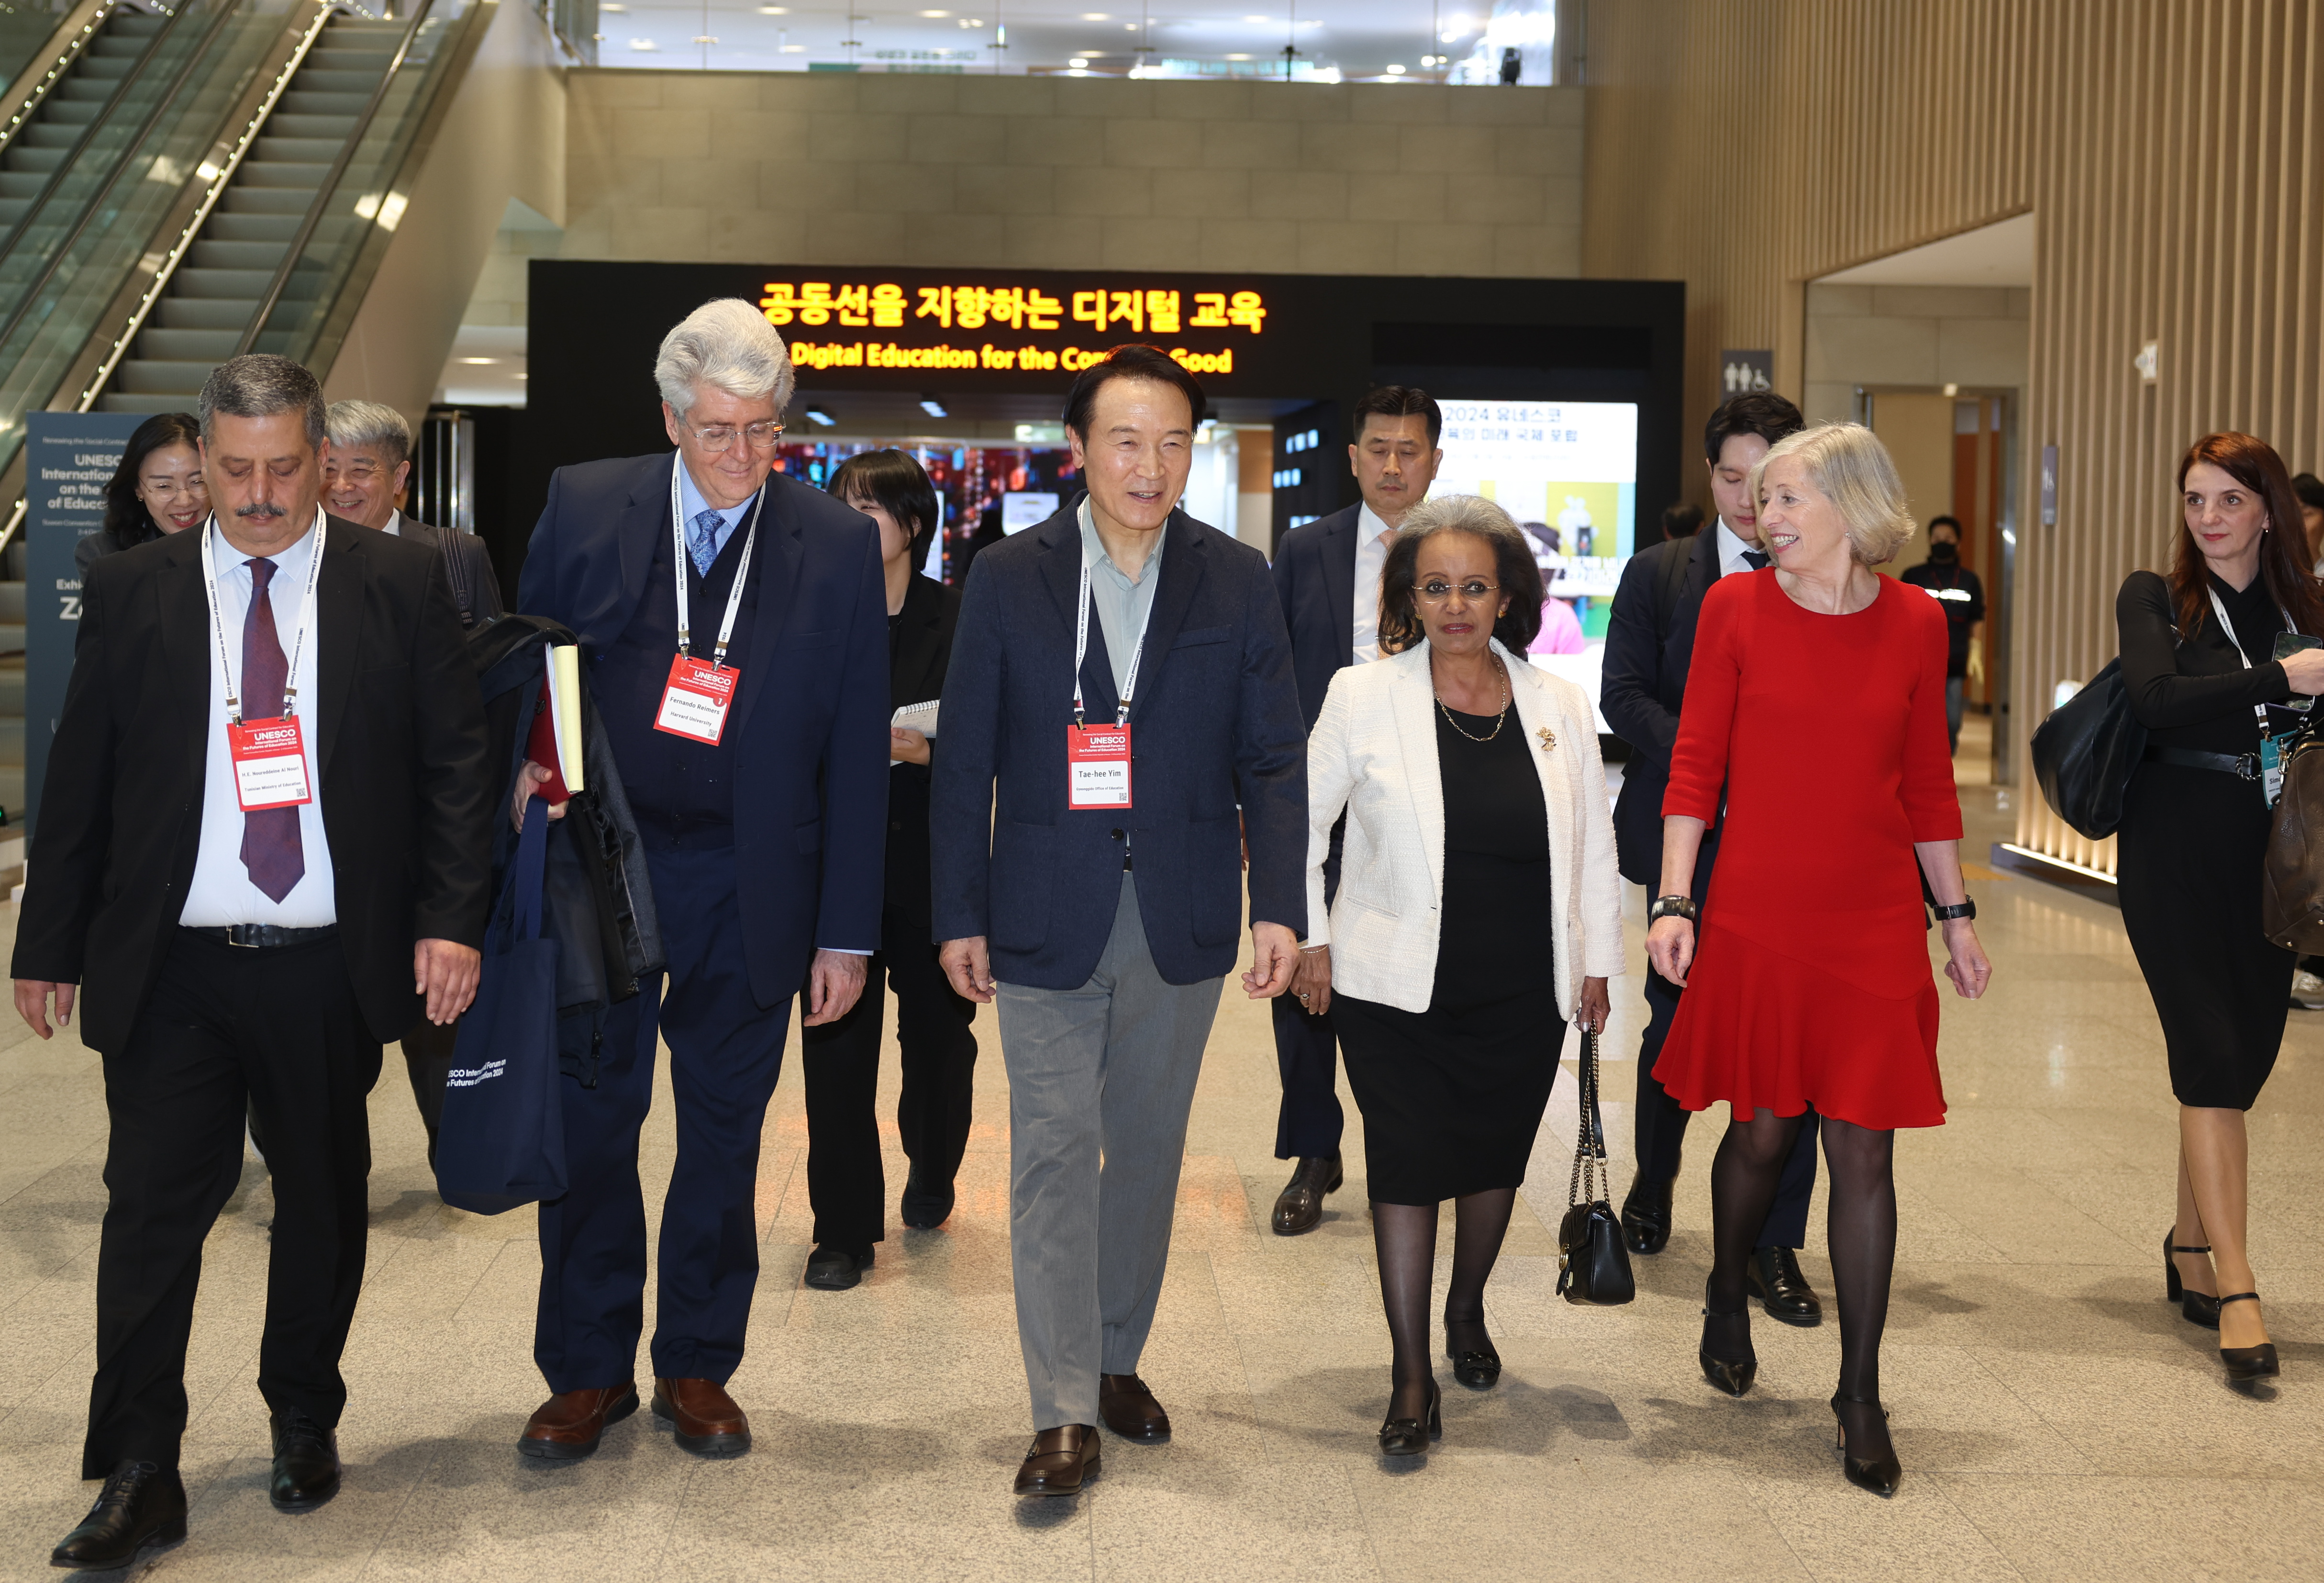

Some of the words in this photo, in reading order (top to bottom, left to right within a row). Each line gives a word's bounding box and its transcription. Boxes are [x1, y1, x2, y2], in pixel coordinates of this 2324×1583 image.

[759, 281, 909, 327] 공동선을
[914, 285, 1064, 330] 지향하는
[1072, 289, 1181, 333] 디지털
[1189, 290, 1267, 334] 교육
[789, 341, 864, 370] Digital
[866, 343, 978, 369] Education
[979, 344, 1016, 369] for
[1017, 345, 1057, 370] the
[1444, 407, 1490, 422] 2024
[1439, 427, 1476, 441] 육의
[75, 454, 123, 467] UNESC
[42, 467, 115, 480] Internation
[59, 484, 77, 495] on
[78, 483, 101, 495] the
[47, 496, 63, 509] of
[64, 497, 108, 510] Educa
[692, 676, 714, 685] International
[694, 670, 732, 686] UNESCO
[670, 696, 696, 708] Fernando
[697, 704, 720, 715] Reimers
[670, 711, 689, 720] Harvard
[689, 716, 712, 727] University
[254, 729, 296, 741] UNESCO
[1090, 736, 1125, 744] UNESCO
[448, 1069, 465, 1078] ESCO
[487, 1060, 501, 1070] Forum
[450, 1079, 474, 1087] Futures
[493, 1067, 503, 1077] 2024
